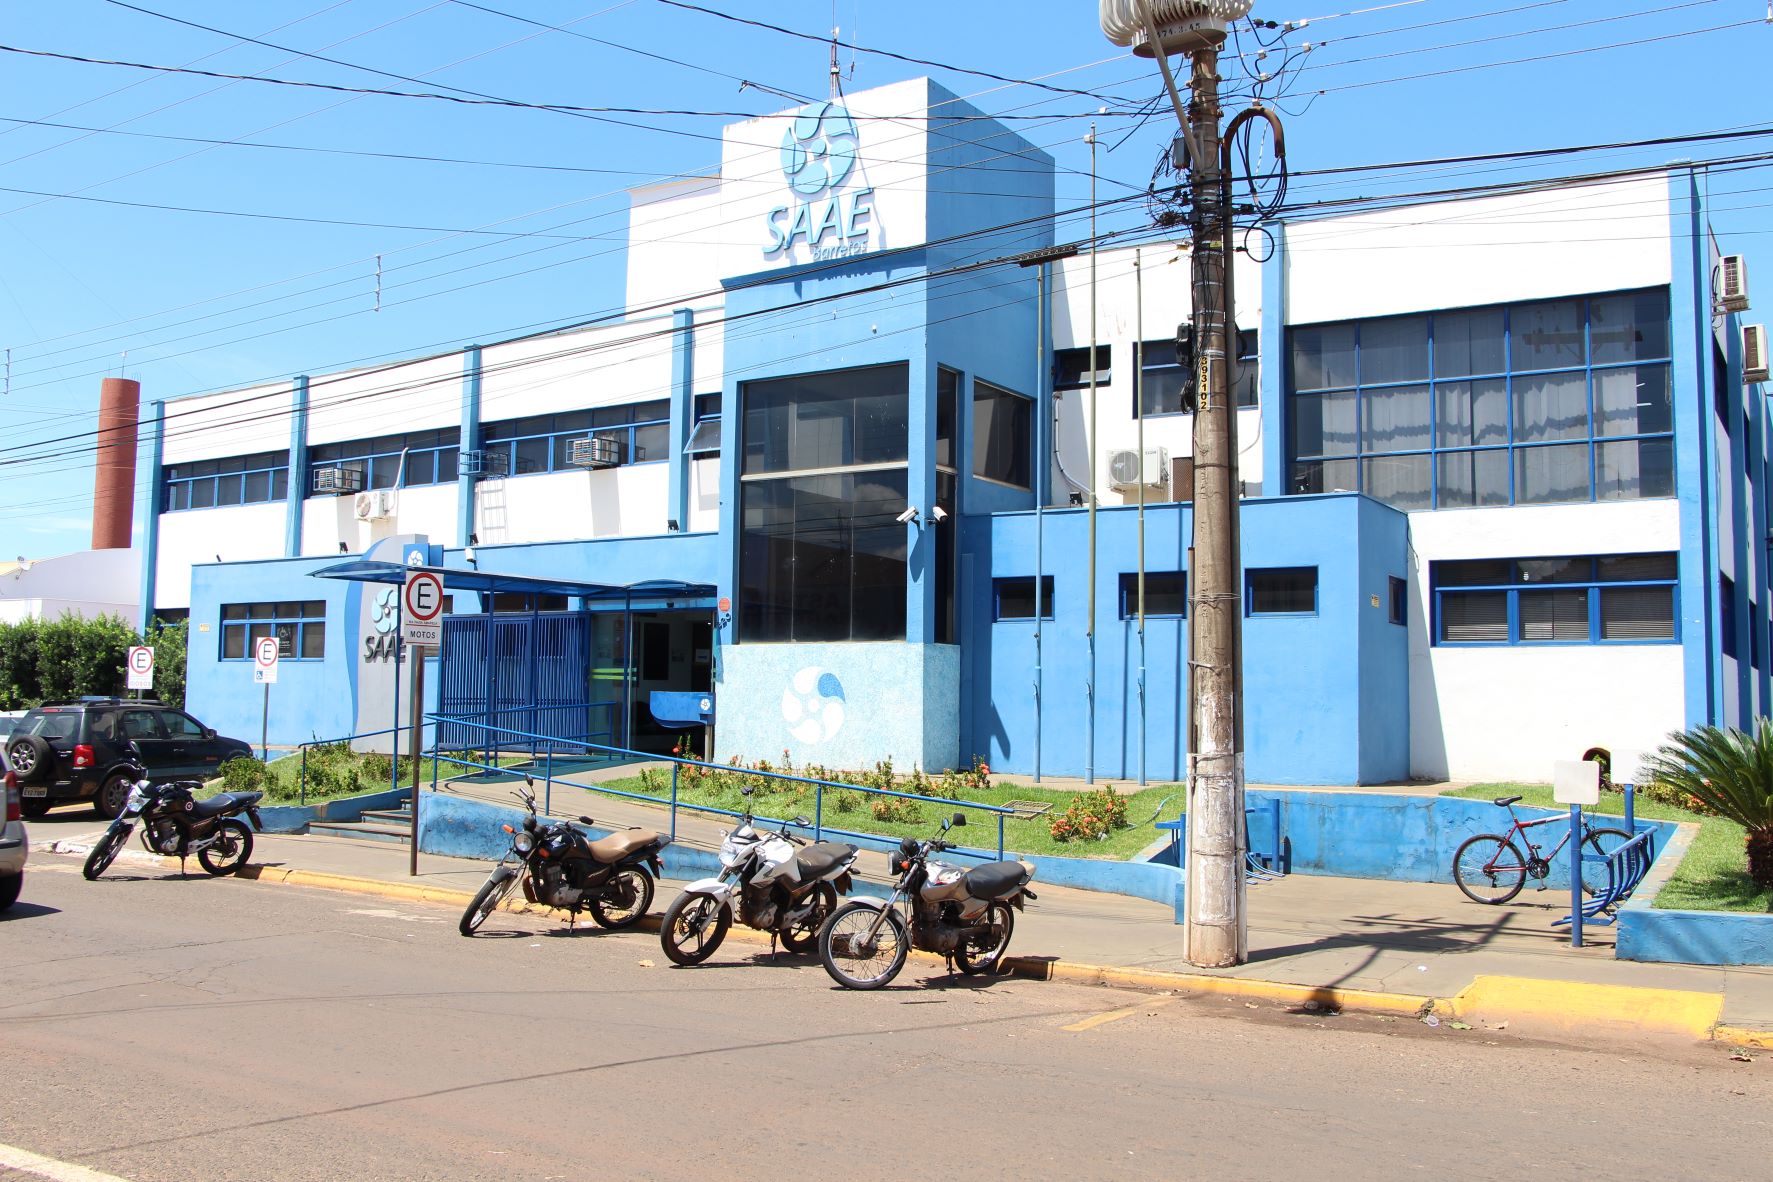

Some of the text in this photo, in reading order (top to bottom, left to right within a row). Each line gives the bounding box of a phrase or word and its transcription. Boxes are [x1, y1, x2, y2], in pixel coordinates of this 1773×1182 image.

[762, 188, 874, 254] SAAE
[813, 240, 868, 260] Barretos
[418, 582, 432, 609] E
[410, 630, 436, 639] MOTOS
[263, 643, 272, 660] E
[364, 635, 407, 661] SAAE
[136, 652, 147, 669] E
